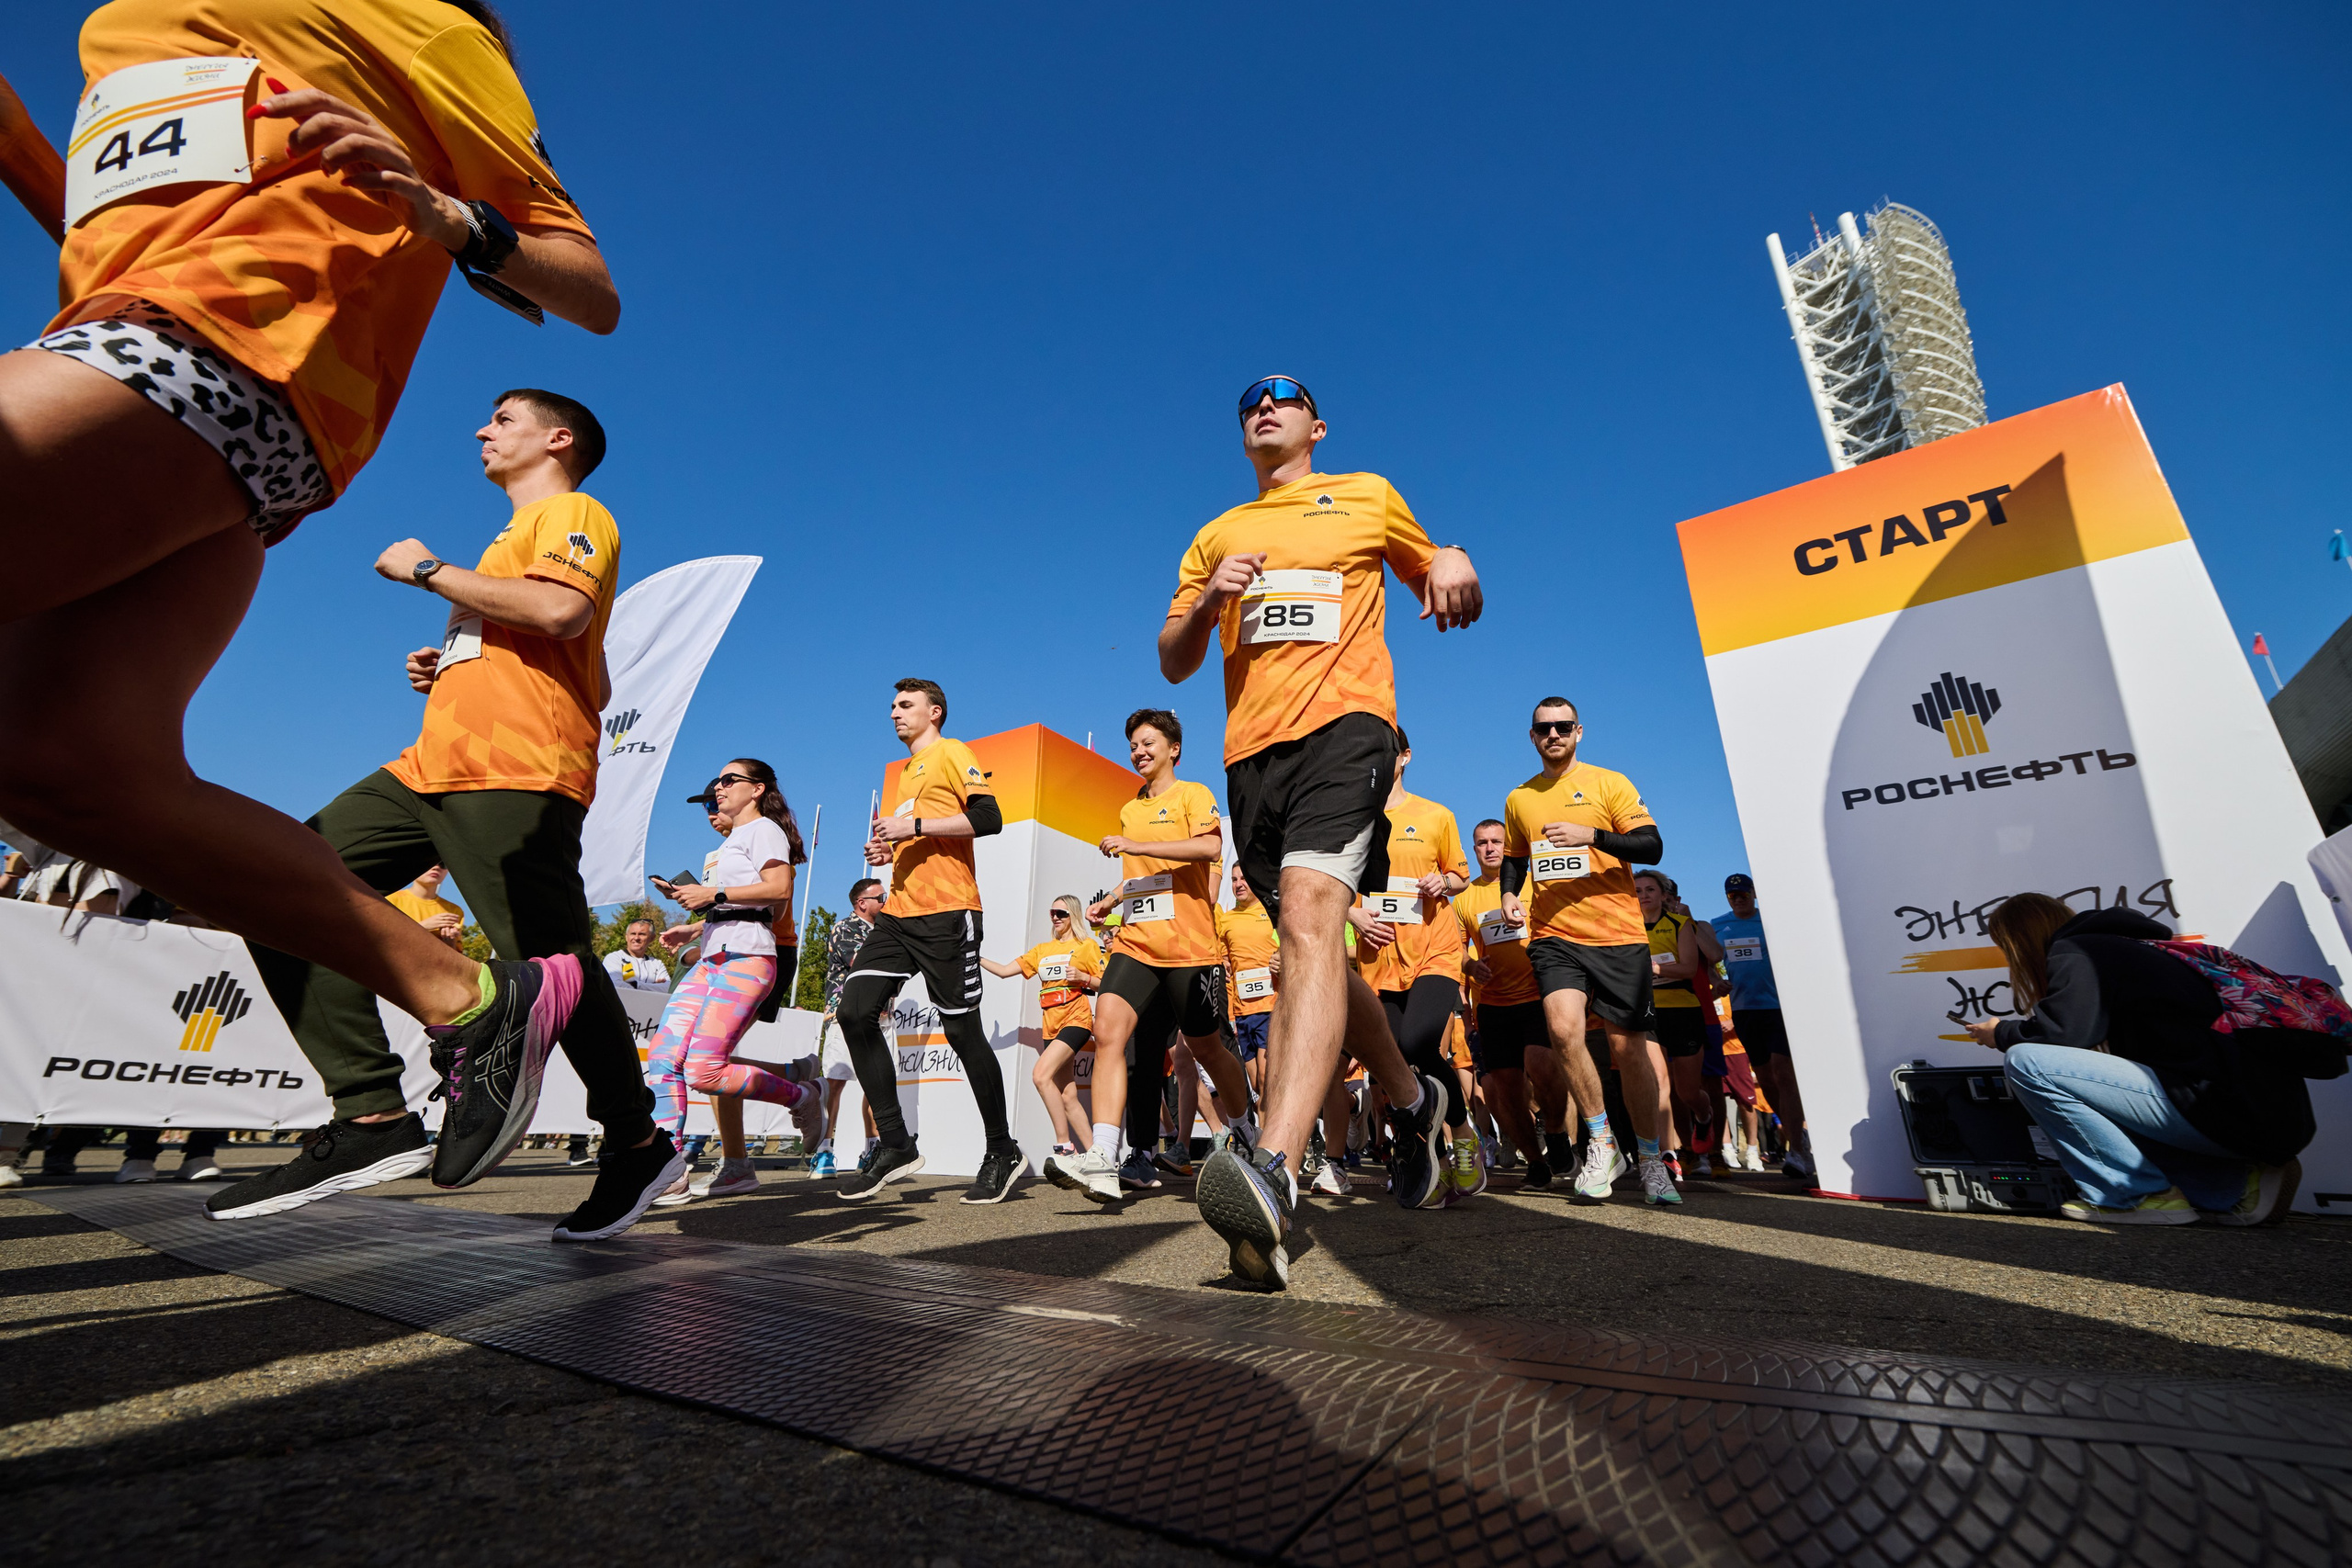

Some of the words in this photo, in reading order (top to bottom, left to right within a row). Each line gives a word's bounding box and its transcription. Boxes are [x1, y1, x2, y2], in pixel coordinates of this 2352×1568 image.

[95, 117, 187, 175] 44
[94, 175, 148, 200] КРАСНОДАР
[150, 168, 178, 179] 2024
[1304, 510, 1351, 518] РОСНЕФТЬ
[1793, 483, 2012, 577] СТАРТ
[1263, 604, 1315, 627] 85
[1841, 749, 2138, 810] РОСНЕФТЬ
[1538, 857, 1582, 873] 266
[1132, 897, 1155, 914] 21
[1382, 898, 1398, 913] 5
[1734, 949, 1753, 957] 38
[1046, 966, 1062, 976] 79
[1245, 982, 1264, 993] 35
[42, 1056, 304, 1090] РОСНЕФТЬ
